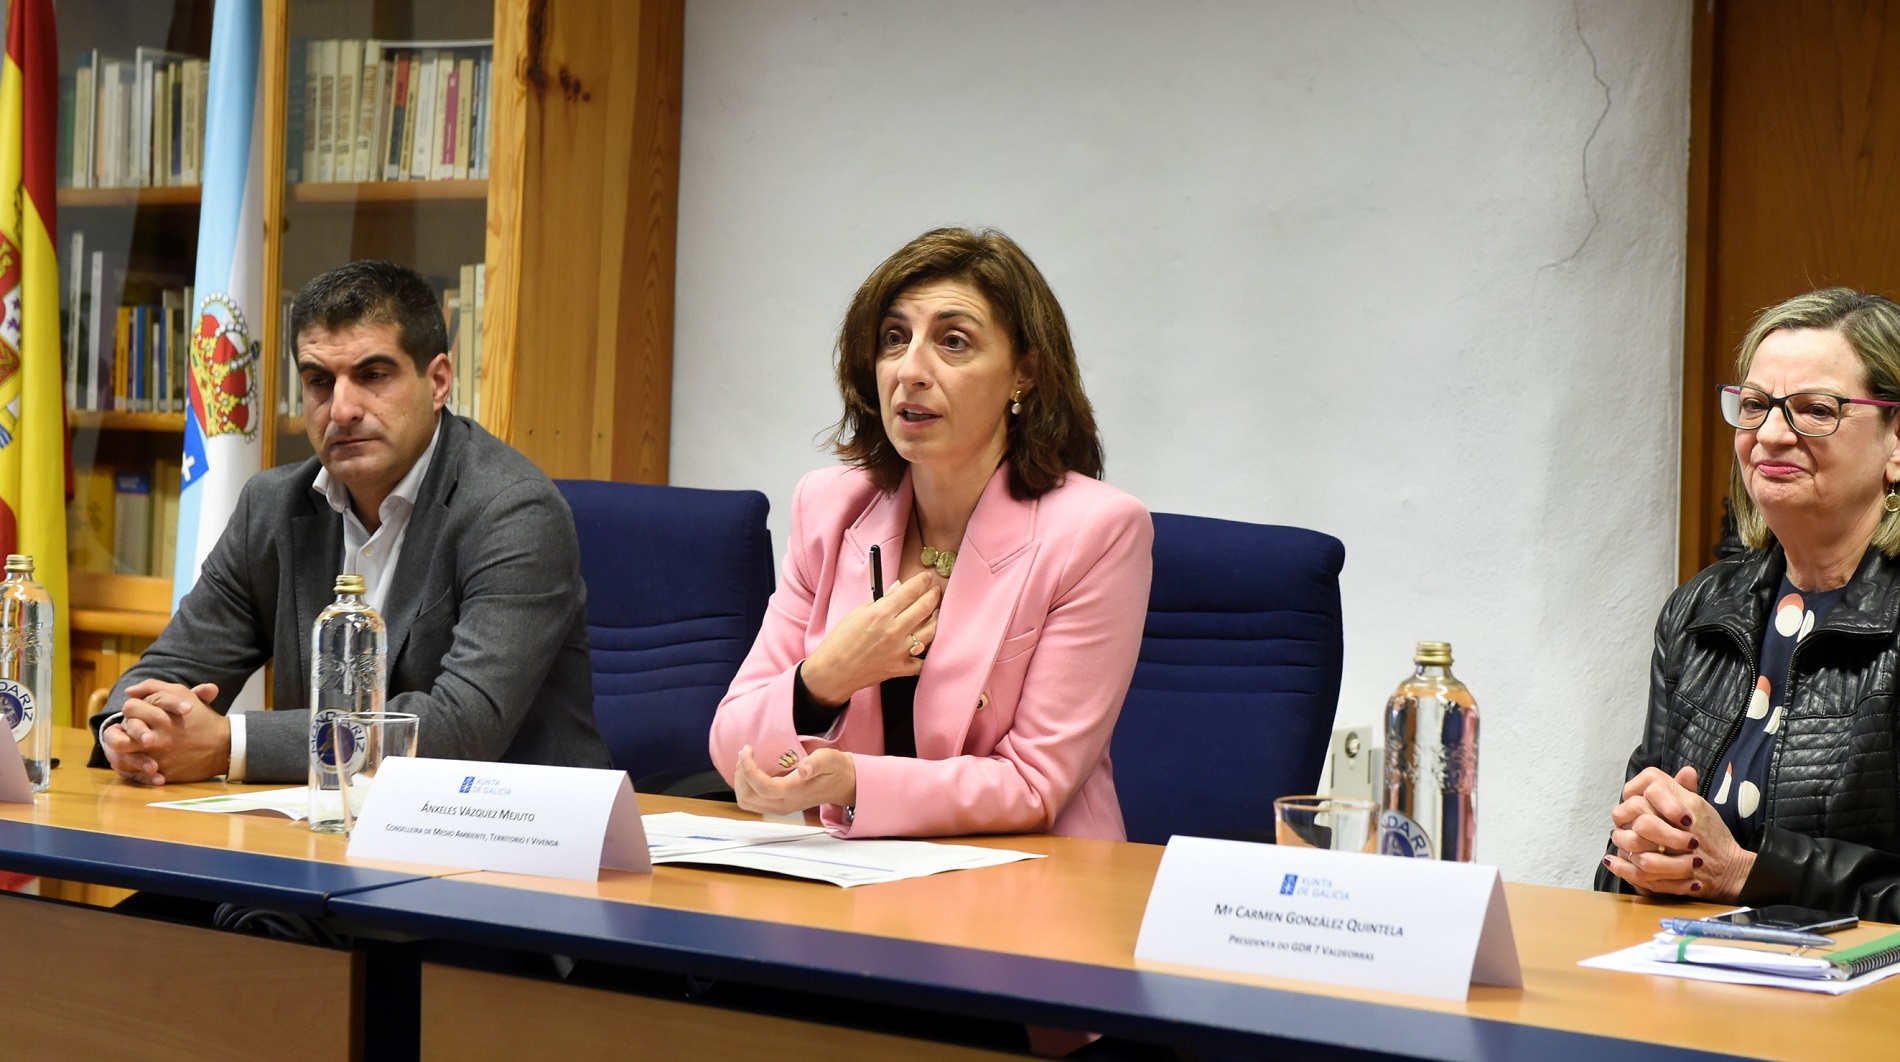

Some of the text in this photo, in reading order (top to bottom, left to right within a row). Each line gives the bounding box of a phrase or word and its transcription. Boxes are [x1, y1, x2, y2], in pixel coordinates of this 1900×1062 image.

[476, 778, 501, 786] XUNTA
[484, 787, 512, 796] GALICIA
[420, 800, 536, 822] ÁNXELES VÁZQUEZ MEJUTO
[385, 823, 423, 834] CONSELLEIRA
[433, 828, 454, 837] MEDIO
[490, 833, 526, 844] TERRITORIO
[532, 837, 559, 847] VIVENDA
[1302, 878, 1333, 887] XUNTA
[1297, 887, 1350, 900] DE GALICIA
[1235, 905, 1282, 922] CARMEN
[1286, 911, 1344, 930] GONZÁLEZ
[1346, 918, 1404, 936] QUINTELA
[1228, 933, 1276, 948] PRESIDENTA
[1277, 942, 1290, 950] DO
[1291, 941, 1313, 953] GDR
[1322, 946, 1375, 961] VALDEORRAS
